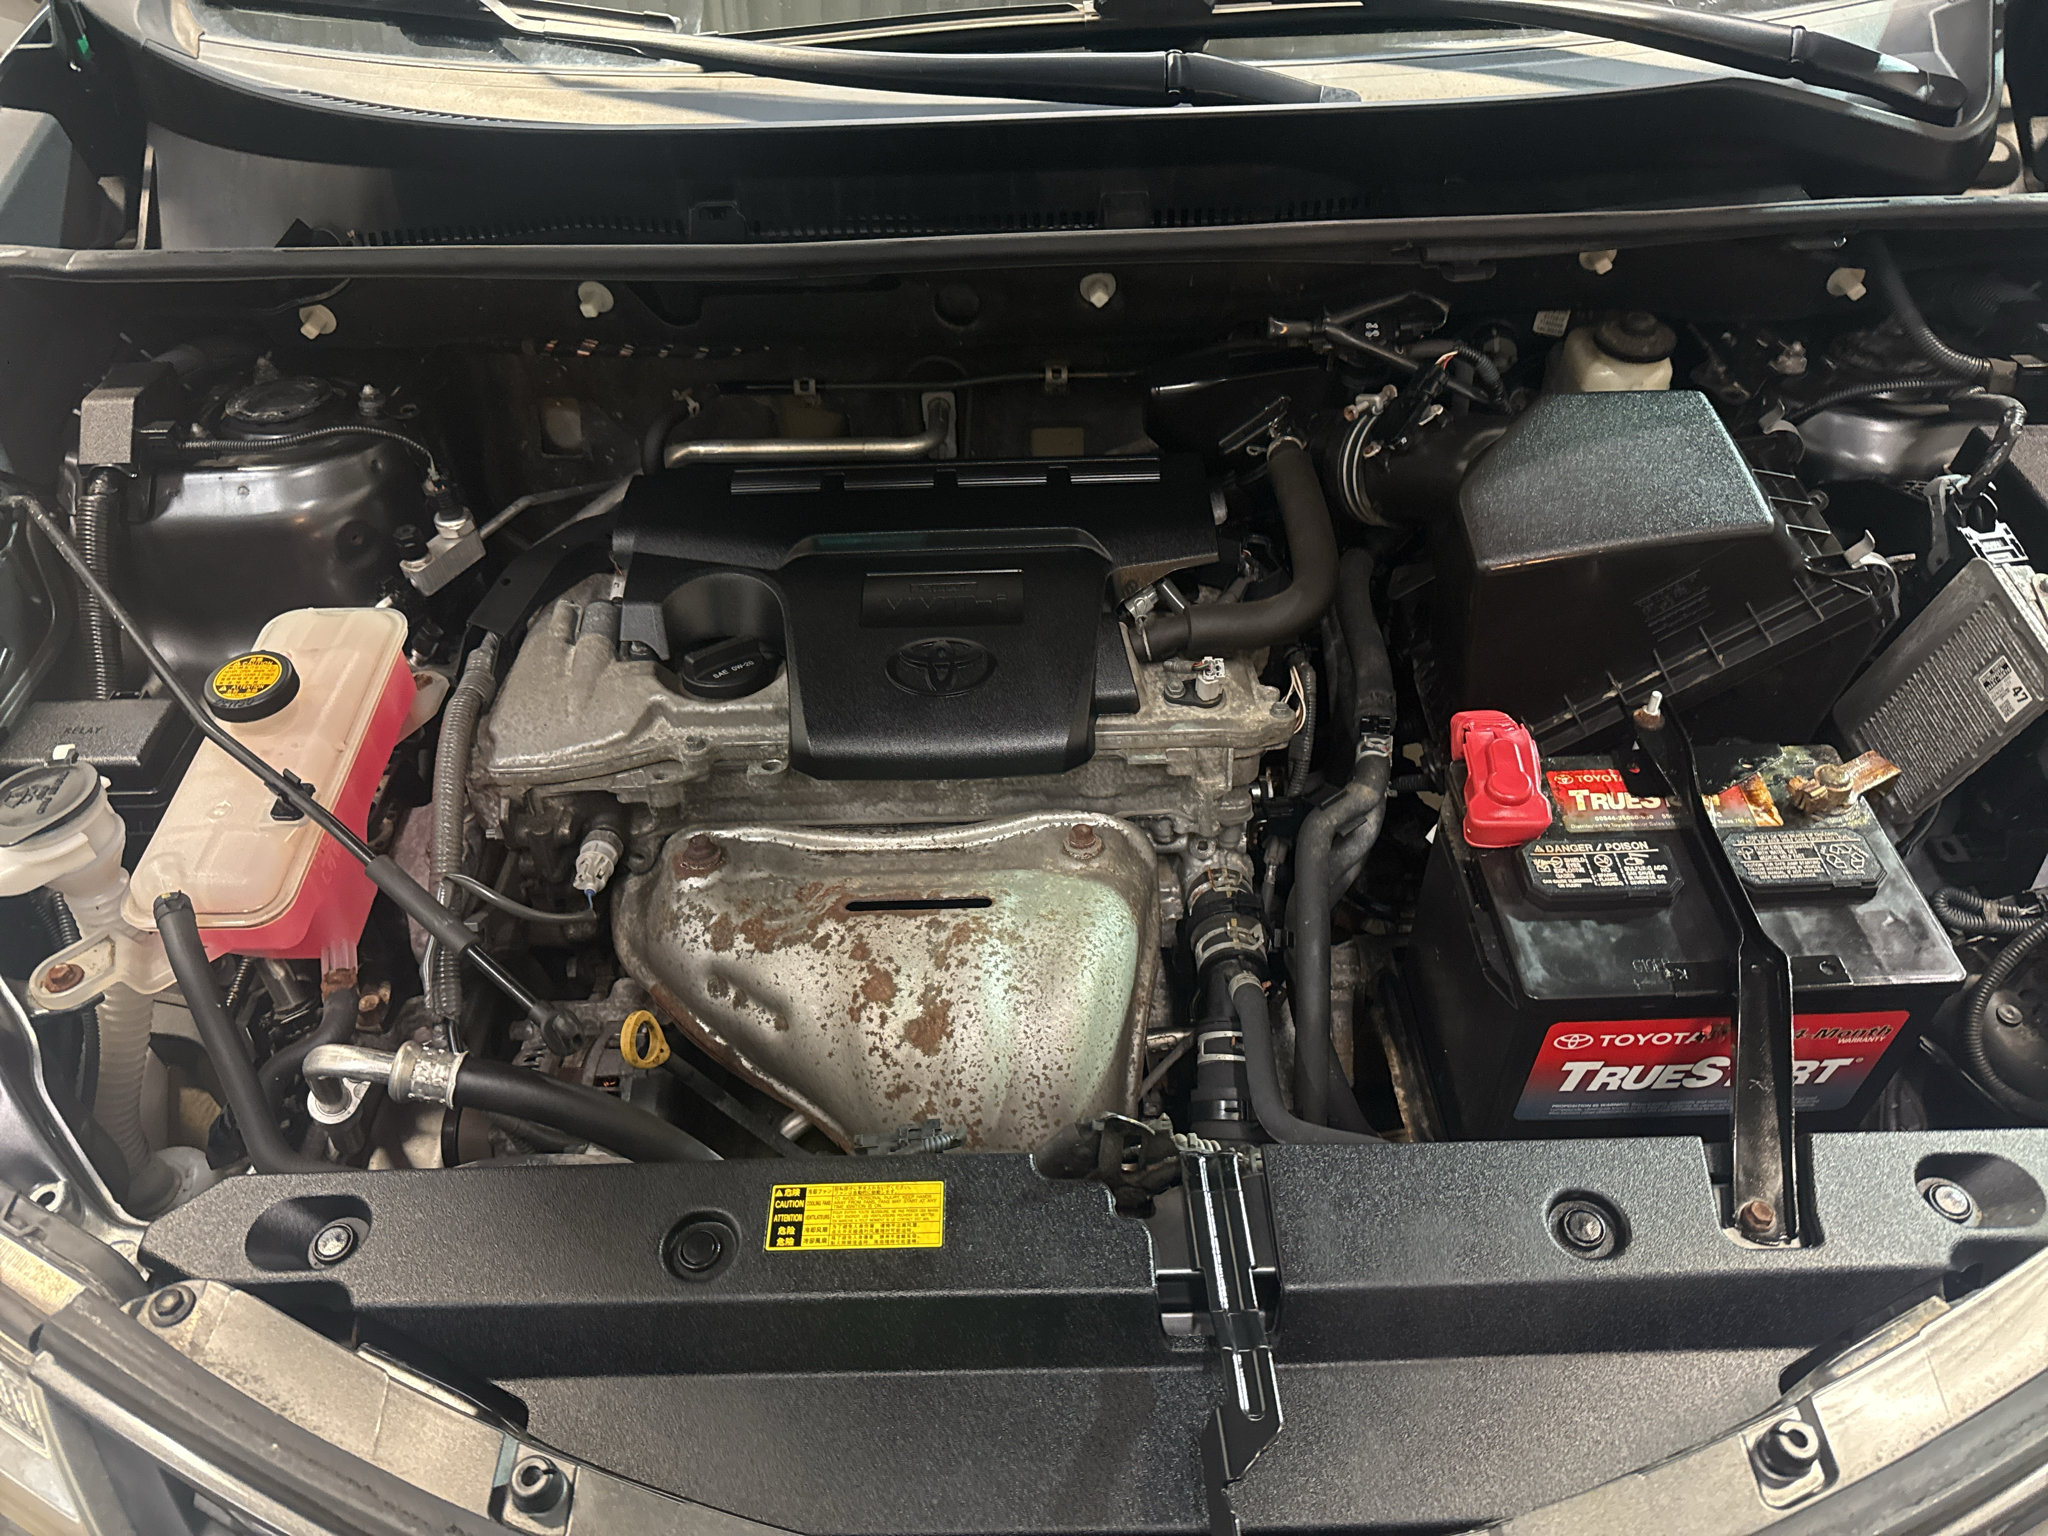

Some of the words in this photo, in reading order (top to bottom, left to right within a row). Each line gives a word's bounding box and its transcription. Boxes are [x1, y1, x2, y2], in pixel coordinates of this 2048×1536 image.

[712, 669, 729, 679] SAE
[731, 660, 755, 672] 0W-20
[2012, 686, 2029, 703] 47
[1575, 774, 1623, 783] TOYOT
[1545, 844, 1593, 853] DANGER
[1604, 841, 1649, 851] POISON
[1600, 1031, 1705, 1047] TOYOTA
[1838, 1036, 1886, 1044] WARRANTY
[1559, 1055, 1855, 1092] TRUESRT
[775, 1200, 804, 1208] CAUTION
[774, 1214, 803, 1222] ATTENTION
